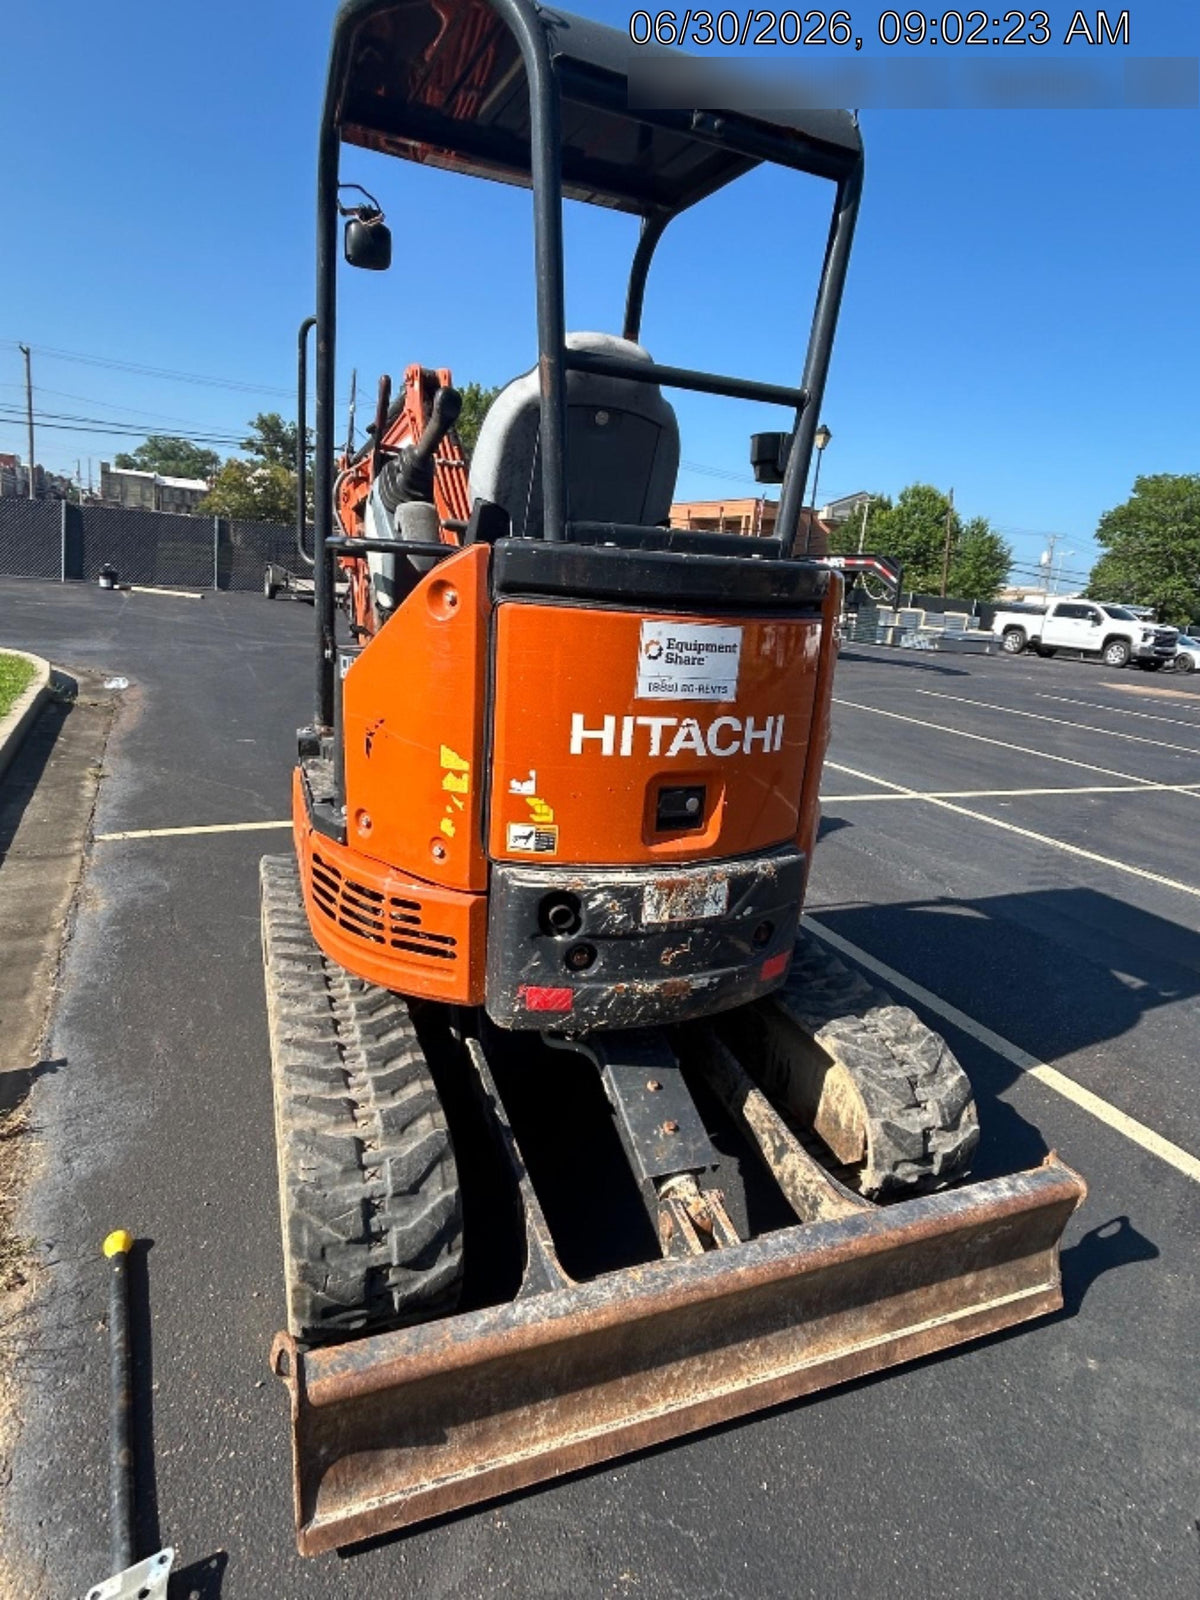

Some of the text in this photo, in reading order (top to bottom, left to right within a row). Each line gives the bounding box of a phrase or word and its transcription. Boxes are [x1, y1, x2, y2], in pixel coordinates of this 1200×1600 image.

[666, 638, 738, 654] Equipment
[664, 652, 706, 666] Share
[569, 712, 785, 757] HITACHI
